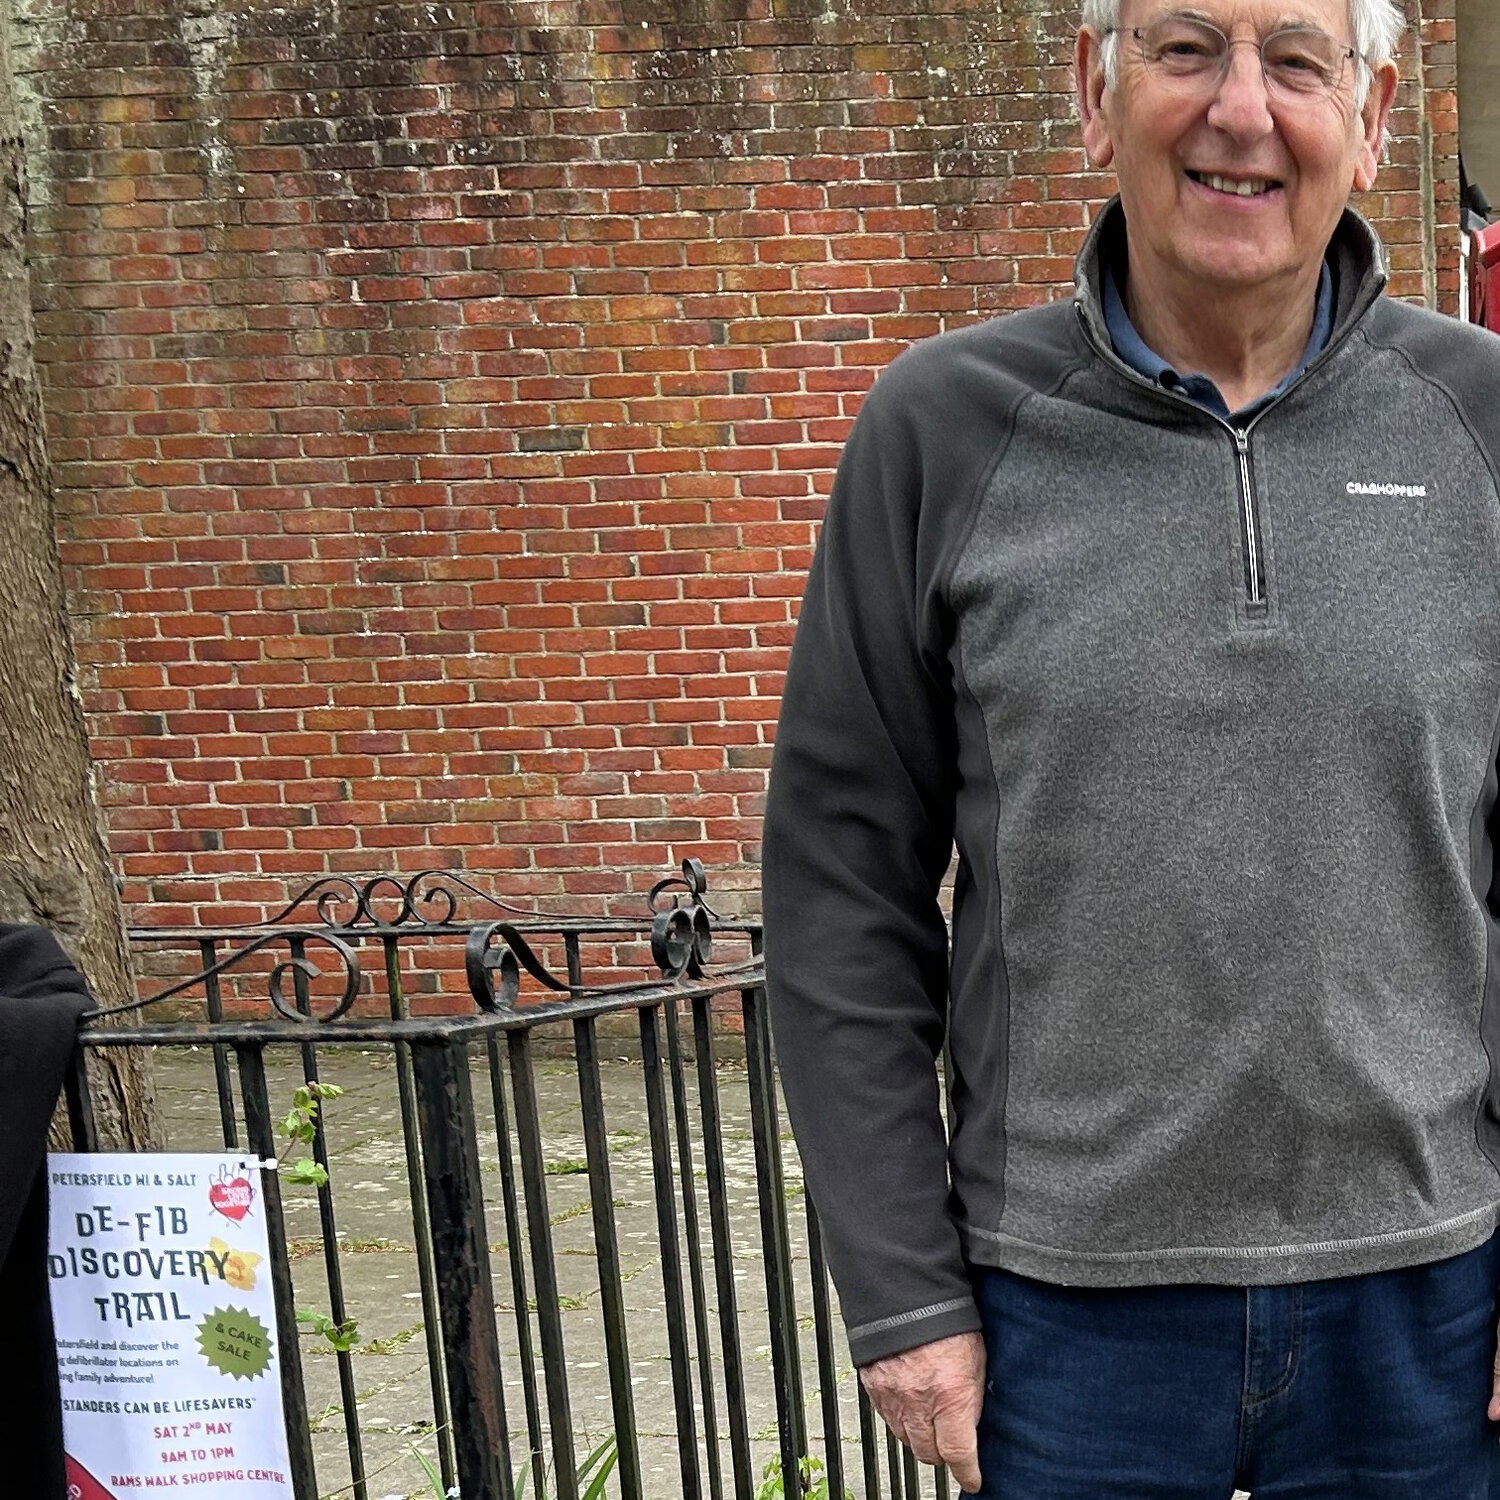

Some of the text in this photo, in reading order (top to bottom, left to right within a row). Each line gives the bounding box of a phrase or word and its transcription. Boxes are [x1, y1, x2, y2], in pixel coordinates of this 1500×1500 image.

[51, 1172, 132, 1187] PETERSFIELD
[153, 1173, 163, 1187] &
[167, 1173, 197, 1187] SALT
[75, 1205, 188, 1242] DE-FIB
[48, 1246, 231, 1286] DISCOVERY
[94, 1291, 191, 1329] TRAIL
[213, 1321, 264, 1350] & CAKE
[57, 1338, 180, 1351] etersfield and discover the
[217, 1340, 252, 1361] SALE
[119, 1356, 164, 1368] locations
[165, 1358, 180, 1367] on
[74, 1371, 102, 1385] family
[63, 1399, 121, 1414] STANDERS
[124, 1401, 149, 1414] CAN
[153, 1400, 171, 1414] BE
[153, 1425, 178, 1439] SAT
[205, 1422, 233, 1436] MAY
[161, 1446, 235, 1463] 9AM TO 1PM
[110, 1469, 286, 1487] RAMS WALK SHOPPING CENTRE
